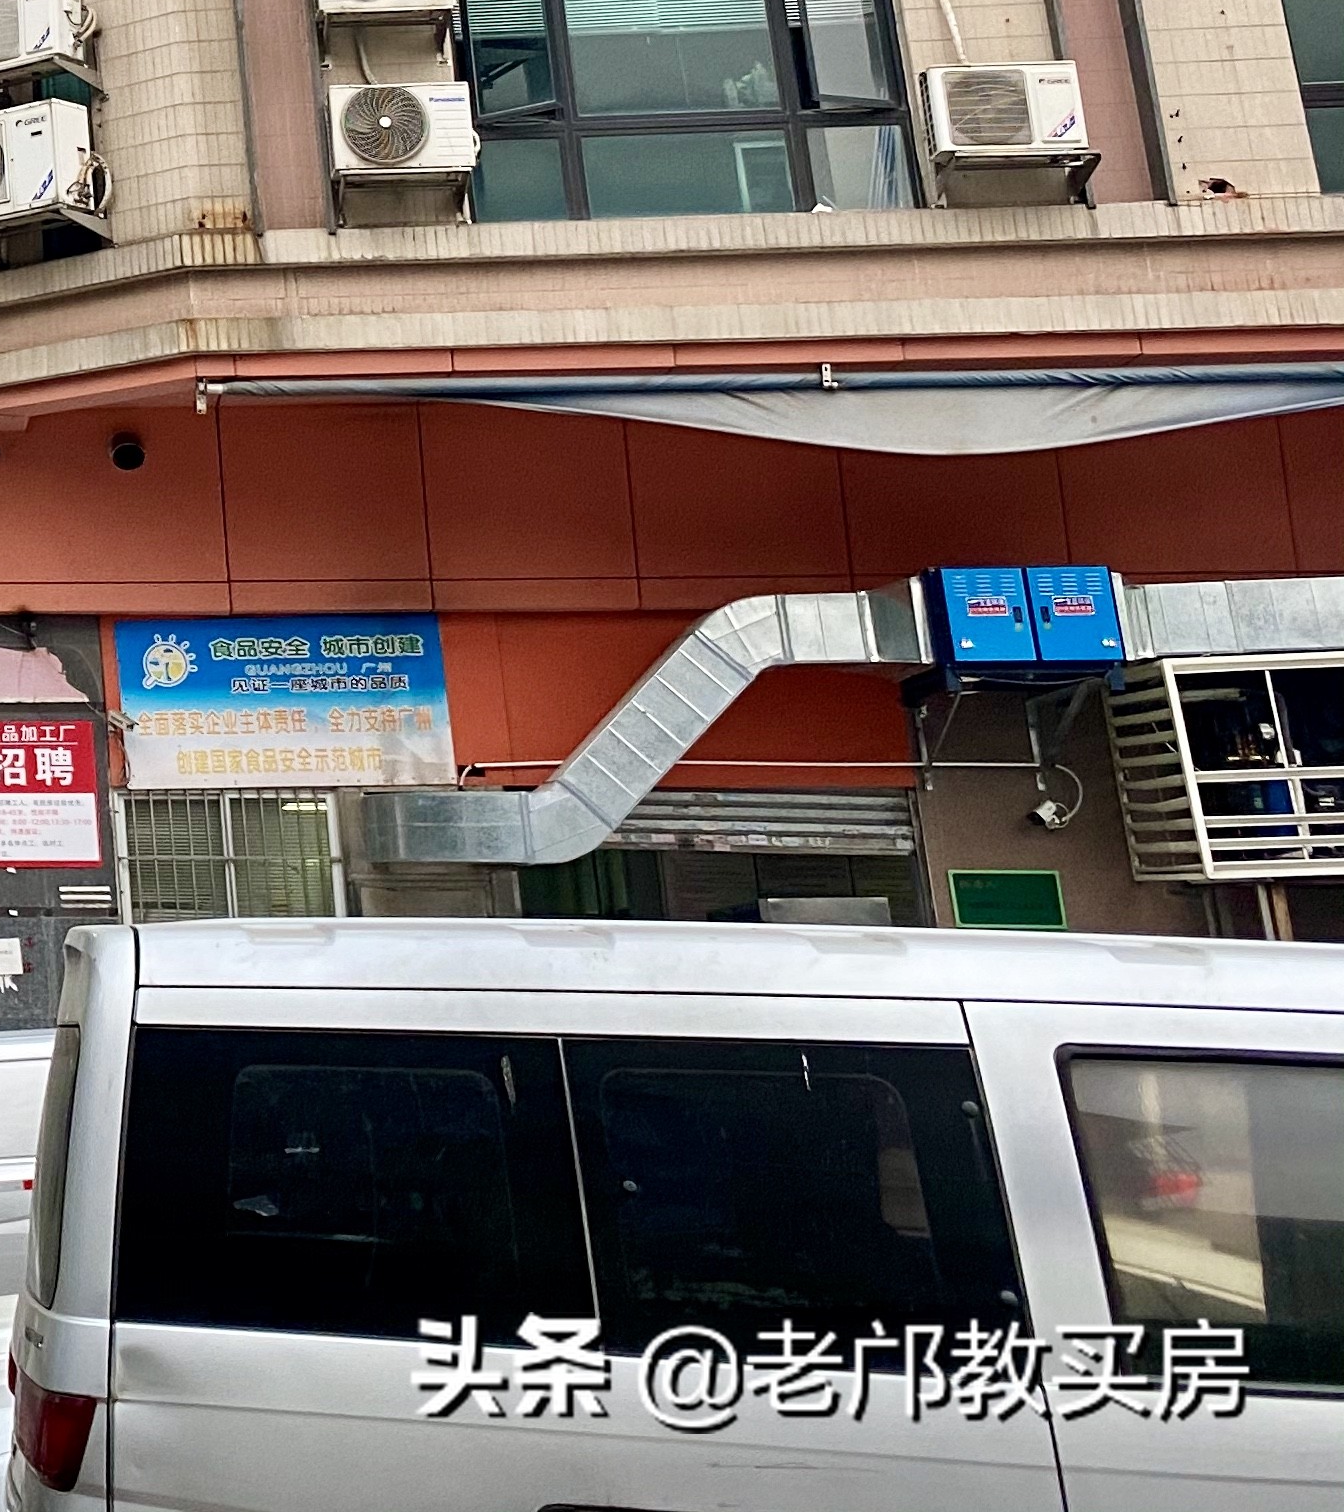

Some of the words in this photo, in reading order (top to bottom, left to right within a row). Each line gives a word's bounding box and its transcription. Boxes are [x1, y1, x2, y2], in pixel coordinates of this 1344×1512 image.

[209, 637, 310, 660] 食品安全
[321, 633, 424, 658] 城市创建
[231, 675, 410, 694] 见证一座城市的品质
[176, 746, 384, 775] 创建国家食品安全示范城市
